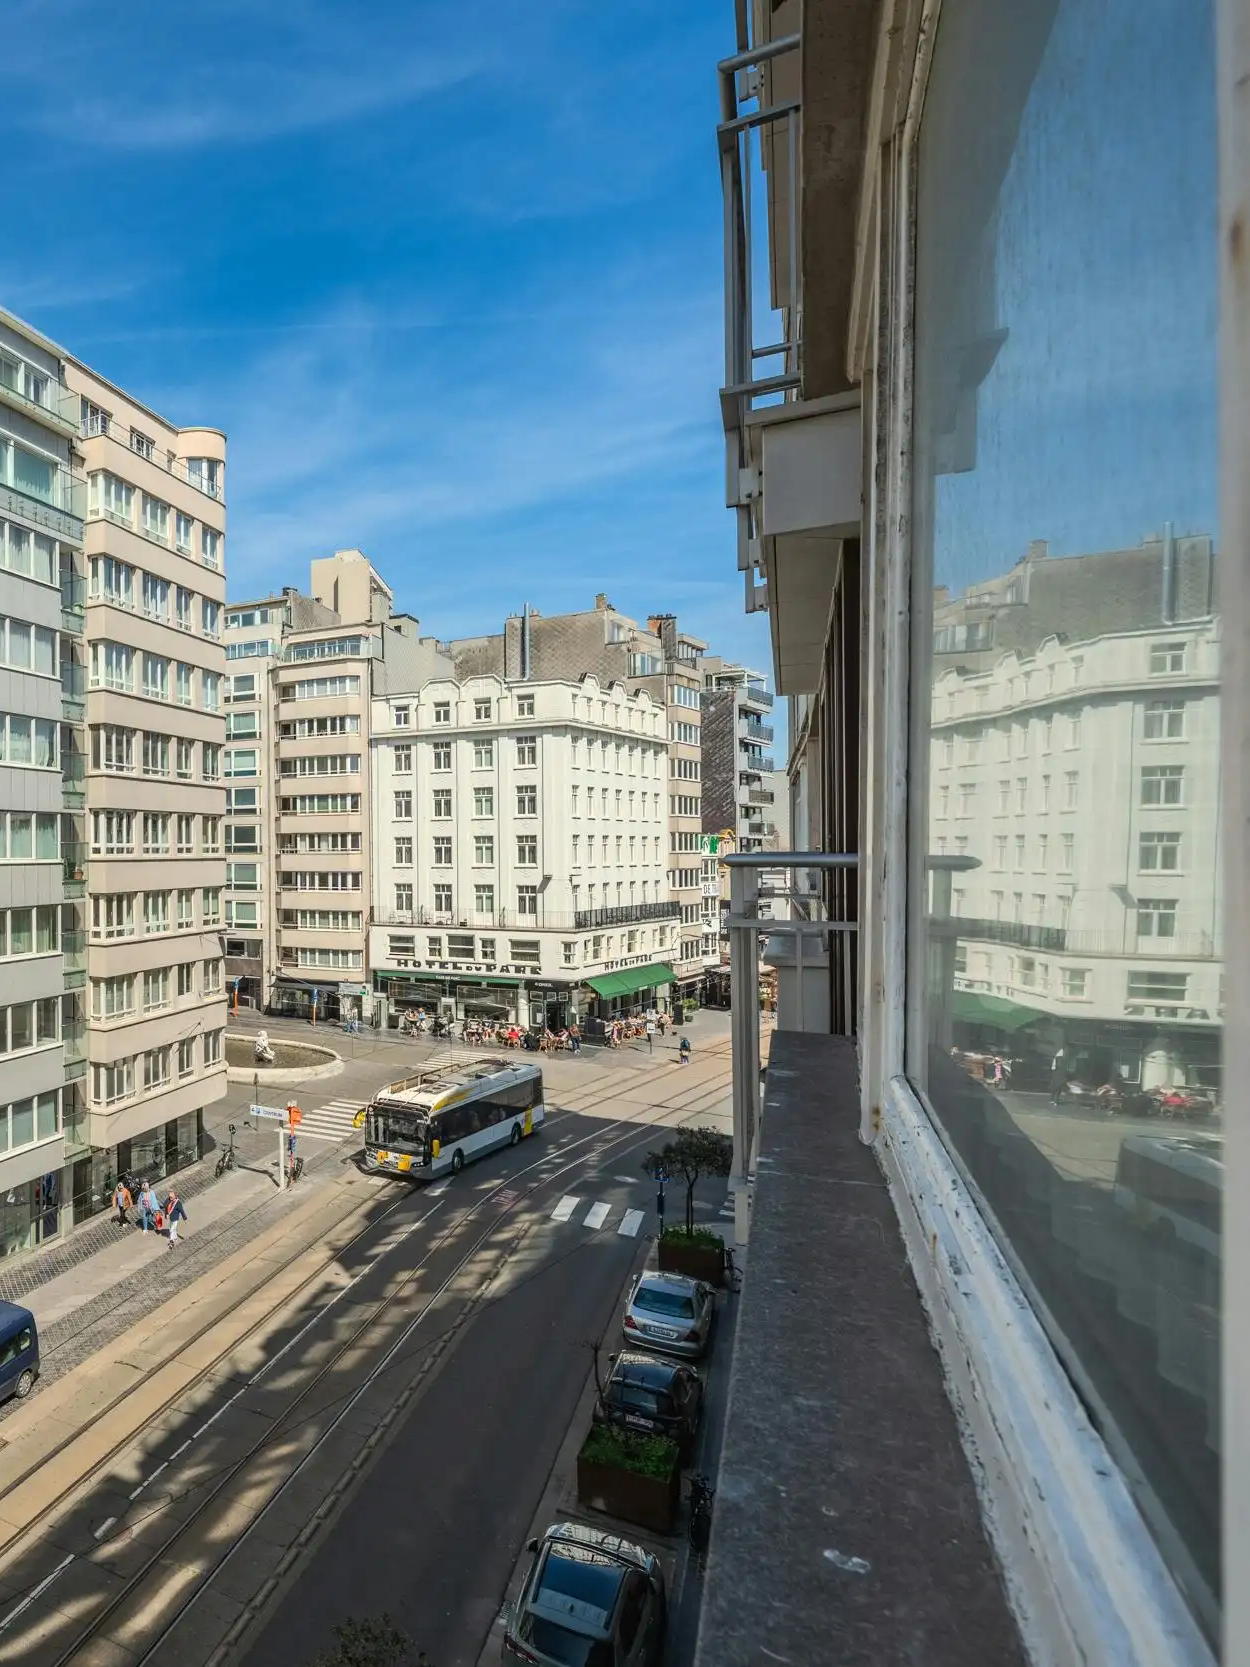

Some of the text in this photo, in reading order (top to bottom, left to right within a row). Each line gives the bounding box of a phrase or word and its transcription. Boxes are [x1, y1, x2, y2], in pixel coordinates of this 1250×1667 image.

[397, 960, 462, 970] HOTEL
[485, 963, 542, 975] PARC
[604, 958, 629, 970] HOTEL
[262, 1110, 283, 1118] CENTRUM
